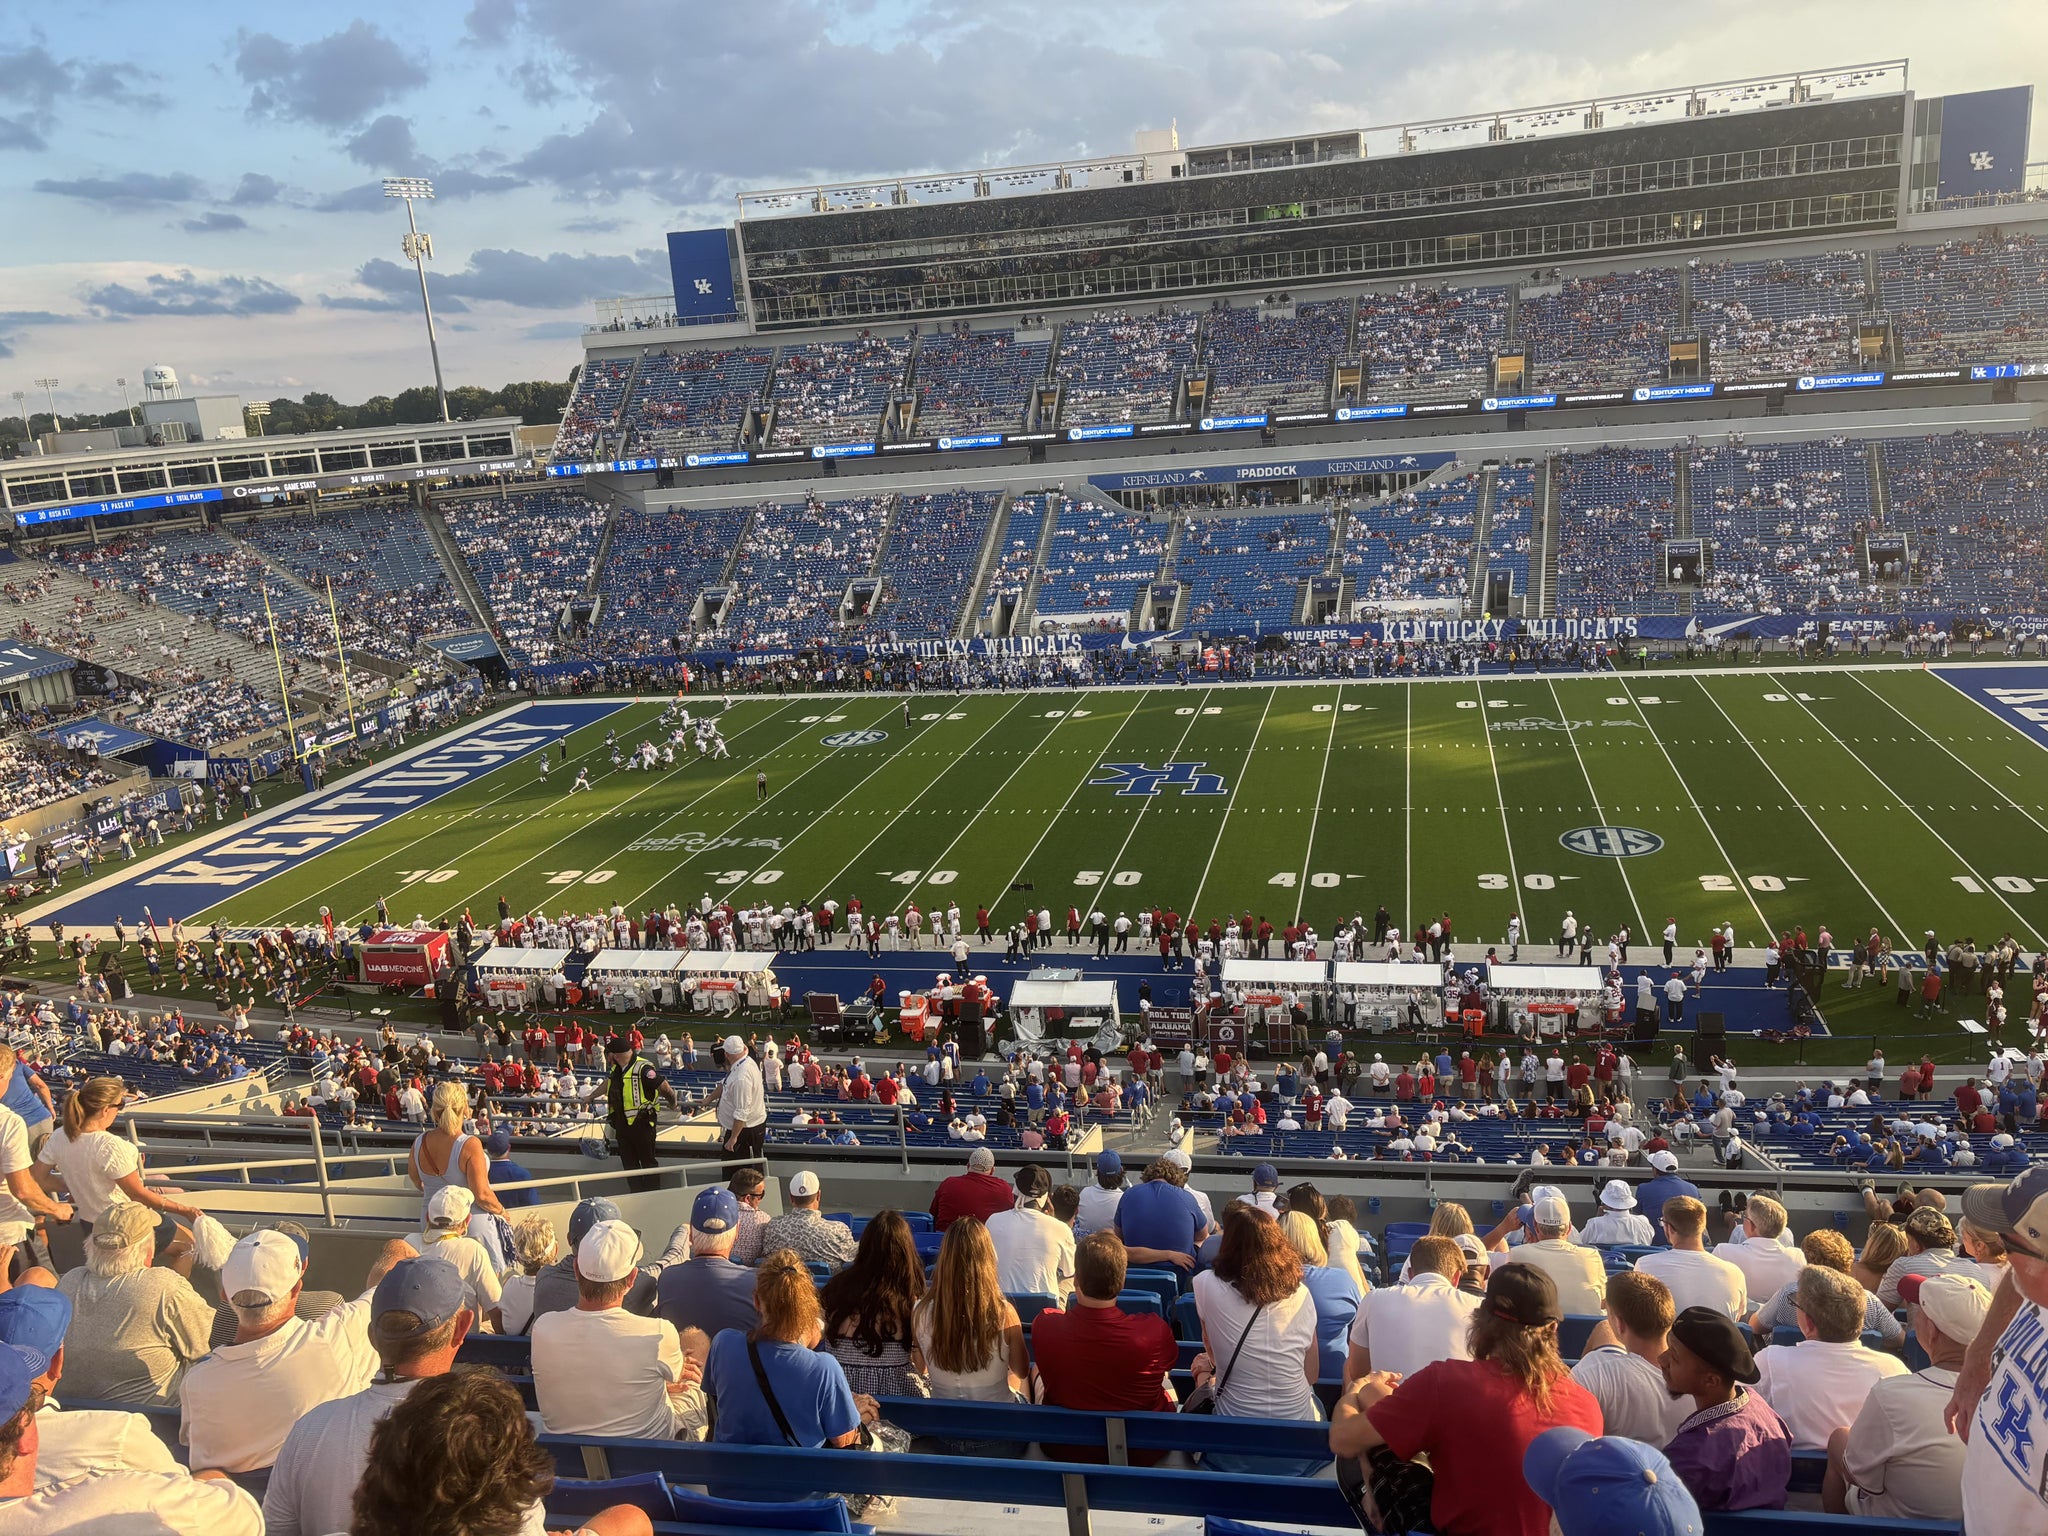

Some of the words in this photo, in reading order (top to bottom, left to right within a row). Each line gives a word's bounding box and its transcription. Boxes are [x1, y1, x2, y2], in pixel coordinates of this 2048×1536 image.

[1969, 151, 1994, 171] UK
[693, 278, 713, 294] UK
[1892, 371, 1960, 380] KENTUCKYMOBILE.COM
[1995, 366, 2007, 376] 17
[1816, 377, 1852, 385] KENTUCKY
[1853, 375, 1881, 383] MOBILE
[1723, 382, 1787, 391] KENTUCKYMOBILE.COM
[1650, 388, 1684, 396] KENTUCKY
[1498, 398, 1529, 406] KENTUCKY
[1565, 393, 1623, 402] KENTUCKYMOBILE.COM
[1351, 408, 1381, 416] KENTUCKY
[1214, 418, 1243, 426] KENTUCKY
[1082, 428, 1110, 436] KENTUCKY
[951, 438, 978, 446] KENTUCKY
[825, 446, 851, 454] KENTUCKY
[700, 455, 726, 463] KENTUCKY
[620, 460, 637, 470] 5:16
[1328, 459, 1394, 473] KEENELAND
[426, 468, 439, 476] PASS
[1241, 465, 1297, 479] PADDOCK
[350, 476, 359, 484] 34
[361, 475, 374, 483] RUSH
[374, 473, 385, 481] ATT
[1123, 473, 1184, 487] KEENELAND
[267, 485, 281, 493] Bank
[284, 482, 300, 491] GAME
[300, 480, 317, 489] STATS
[176, 494, 190, 502] TOTAL
[190, 492, 204, 501] PLAYS
[100, 503, 109, 512] 31
[111, 501, 125, 510] PASS
[125, 500, 135, 508] ATT
[48, 510, 62, 518] RUSH
[62, 508, 71, 516] ATT
[1382, 619, 1506, 642] KENTUCKY
[1520, 616, 1638, 640] WILDCATS
[865, 639, 970, 657] KENTUCKY
[985, 633, 1083, 657] WILDCATS
[1606, 696, 1662, 706] 20
[1762, 692, 1816, 702] 10
[1312, 703, 1362, 712] 40
[1455, 700, 1510, 709] 30
[1045, 710, 1092, 718] 40
[1174, 706, 1223, 715] 50
[800, 715, 848, 723] 20
[920, 712, 967, 721] 30
[829, 730, 884, 746] SEC
[1087, 762, 1228, 796] UK
[134, 722, 574, 887] KENTUCKY
[97, 816, 118, 832] LLH
[635, 832, 744, 853] Kroger
[1563, 828, 1656, 855] SEC
[400, 869, 460, 884] 10
[545, 870, 618, 885] 20
[714, 870, 785, 885] 30
[890, 870, 959, 885] 40
[1072, 870, 1143, 886] 50
[1267, 872, 1342, 888] 40
[1477, 874, 1556, 891] 30
[1698, 875, 1787, 892] 20
[1951, 876, 2036, 893] 10
[367, 964, 389, 972] UAB
[389, 965, 424, 973] MEDICINE
[1150, 1011, 1169, 1019] ROLL
[1151, 1023, 1192, 1031] ALABAMA
[628, 1032, 633, 1041] 1
[786, 1043, 797, 1052] 27
[1600, 1056, 1606, 1065] 1
[1999, 1061, 2005, 1071] 1
[1313, 1103, 1319, 1112] 8
[1991, 1370, 2034, 1474] UK
